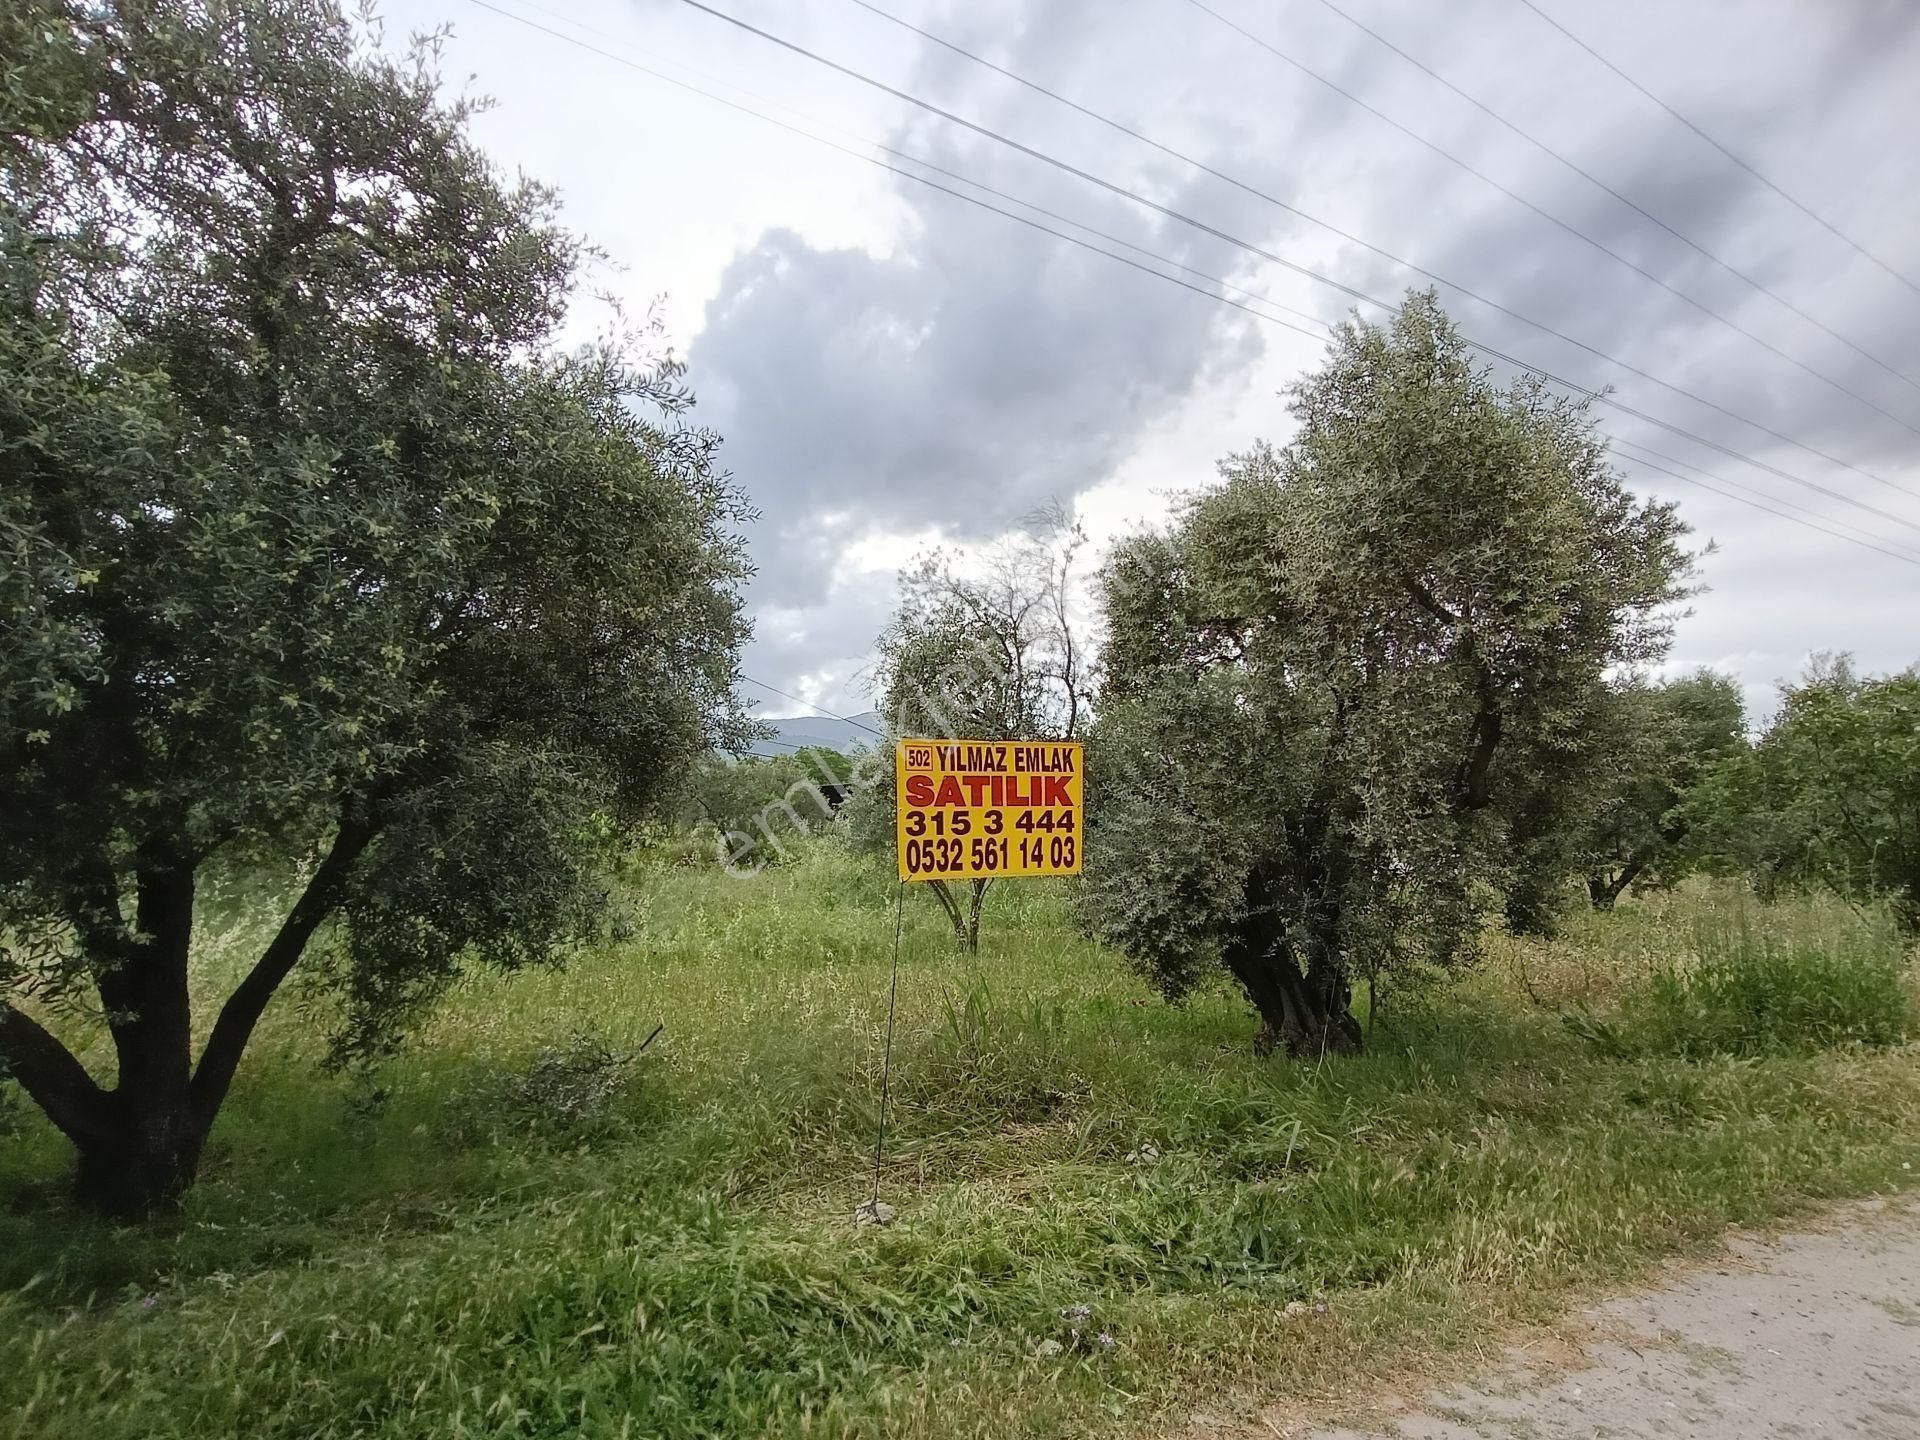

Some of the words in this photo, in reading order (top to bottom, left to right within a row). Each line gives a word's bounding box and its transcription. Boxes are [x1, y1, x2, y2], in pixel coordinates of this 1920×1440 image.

[909, 750, 930, 767] 502
[936, 746, 1006, 772] YILMAZ
[1015, 747, 1074, 772] EMLAK
[906, 775, 1074, 807] SATILIK
[905, 811, 971, 836] 315
[984, 810, 1003, 834] 3
[1016, 810, 1074, 833] 444
[906, 838, 963, 873] 0532
[971, 837, 1008, 871] 561
[1020, 837, 1043, 868] 14
[1051, 836, 1075, 868] 03
